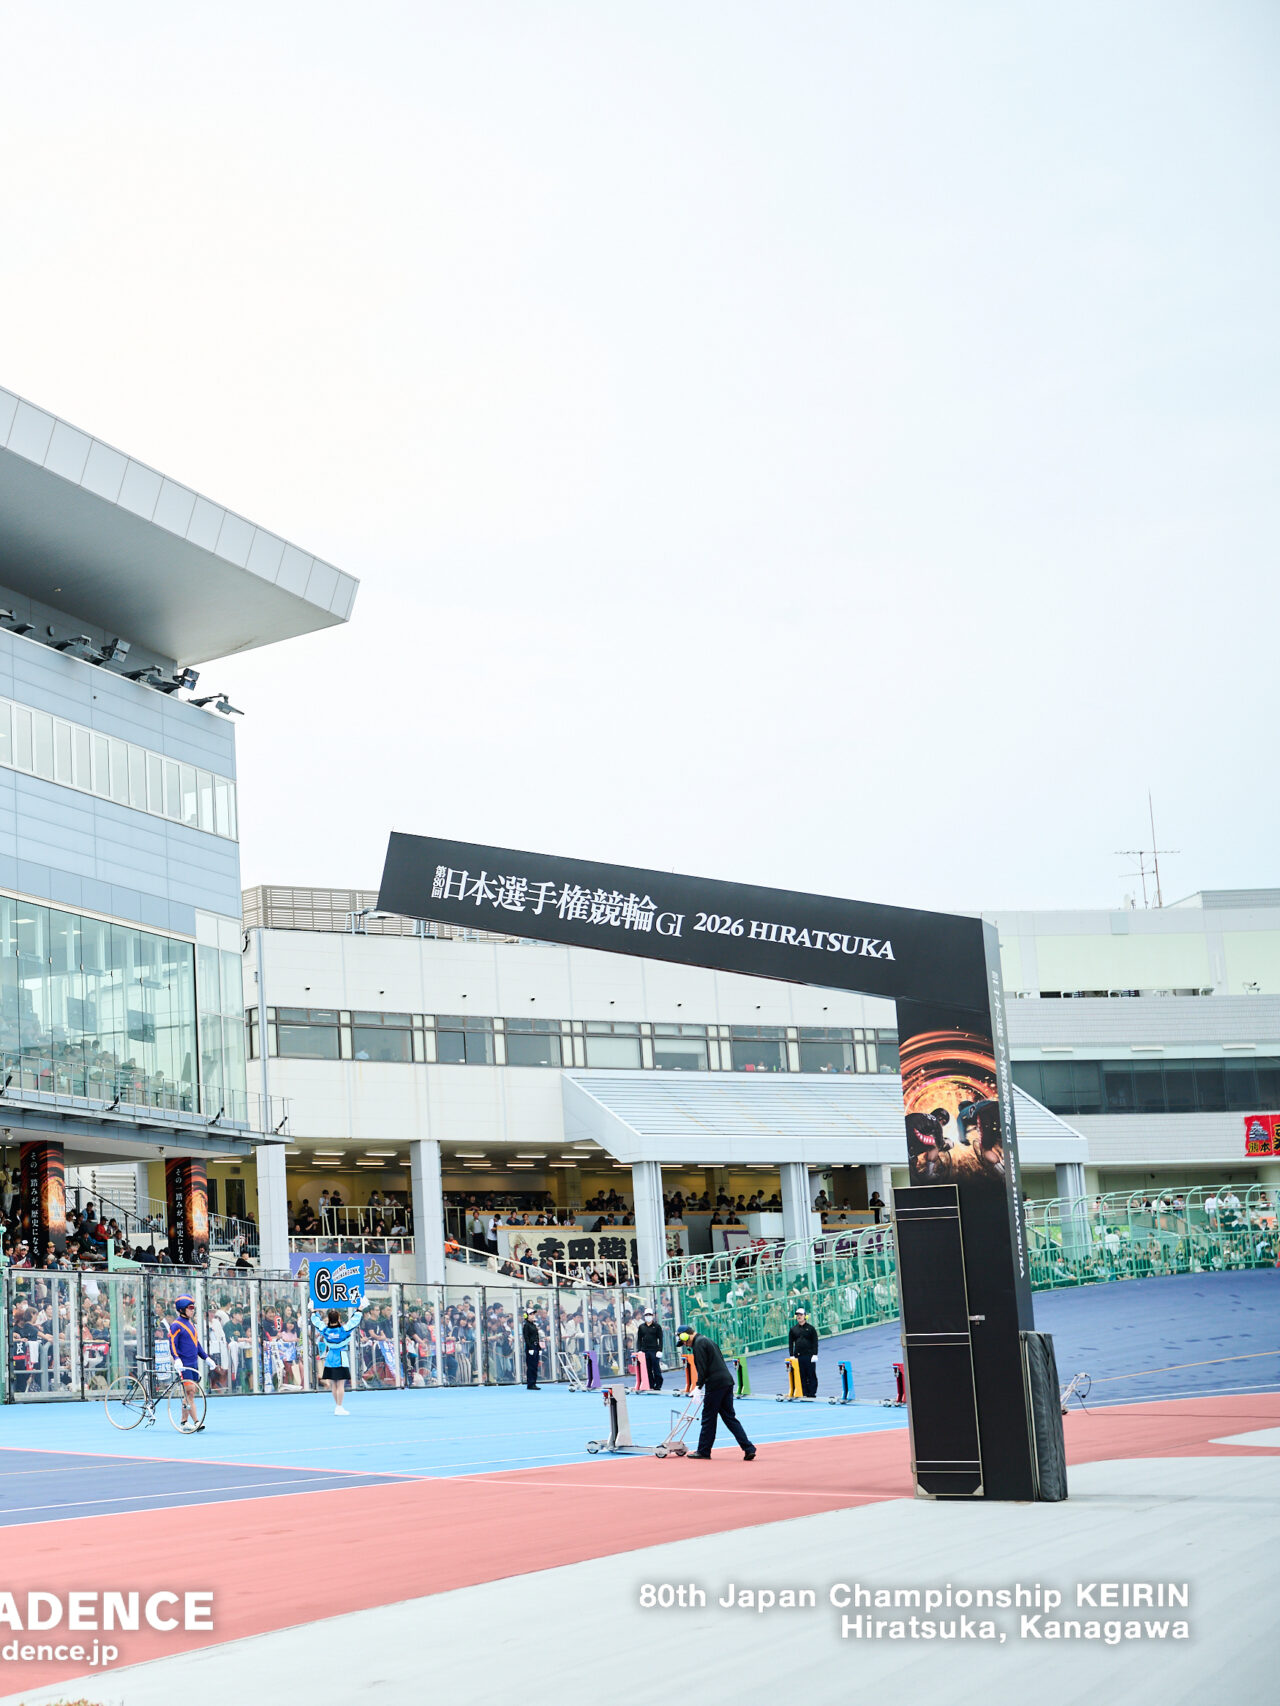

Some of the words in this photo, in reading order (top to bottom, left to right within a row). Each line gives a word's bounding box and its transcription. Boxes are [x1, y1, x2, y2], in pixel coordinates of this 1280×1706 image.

[693, 912, 744, 937] 2026
[748, 920, 896, 961] HIRATSUKA
[1012, 1187, 1025, 1279] HIRATSUKA
